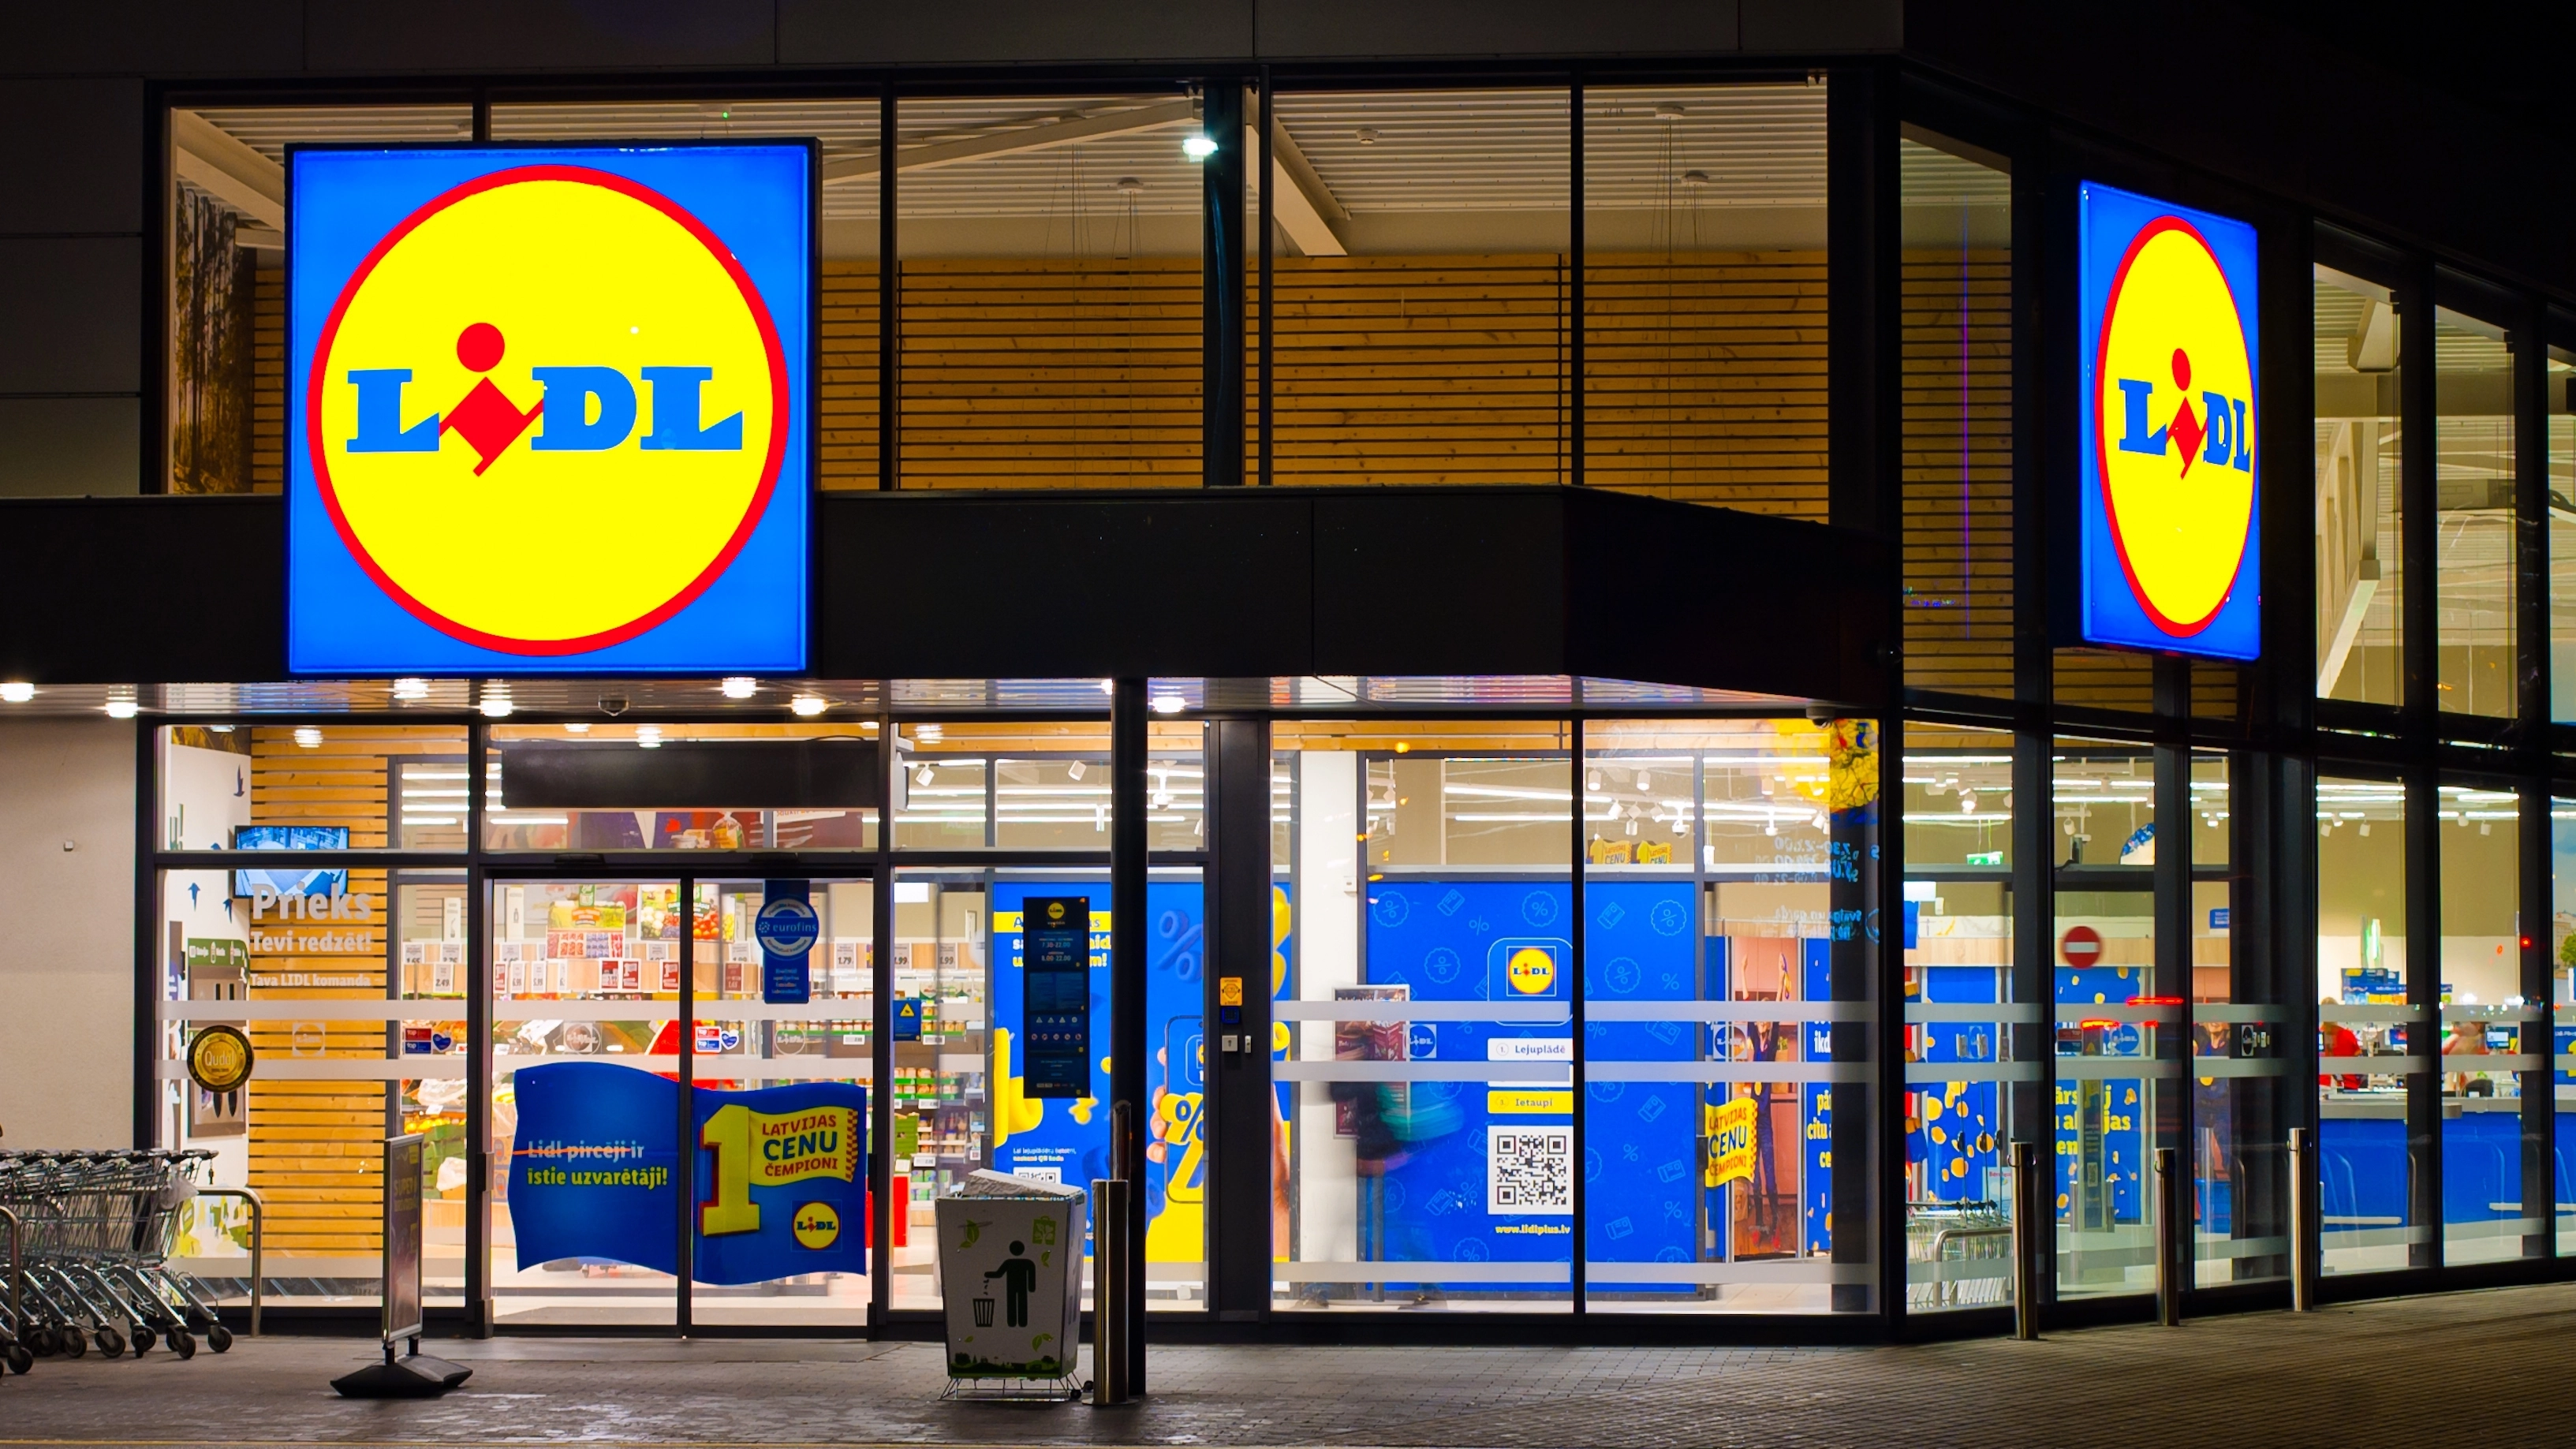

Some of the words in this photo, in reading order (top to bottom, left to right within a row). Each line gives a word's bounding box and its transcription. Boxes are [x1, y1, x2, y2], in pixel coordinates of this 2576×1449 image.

[346, 322, 744, 476] LIDL
[2118, 348, 2251, 480] LIDL
[252, 881, 371, 920] Prieks
[773, 921, 817, 932] eurofins
[251, 930, 293, 952] Tevi
[298, 931, 372, 952] redzēt!
[250, 973, 279, 986] Tava
[281, 973, 311, 986] LIDL
[313, 973, 371, 986] komanda
[205, 1049, 236, 1066] Qudal
[1515, 1044, 1566, 1058] Lejuplādē
[1515, 1098, 1553, 1108] Ietaupi
[762, 1115, 837, 1136] LATVIJAS
[1708, 1107, 1747, 1130] LATVIJAS
[528, 1140, 562, 1159] Lidl
[567, 1140, 626, 1163] pircēji
[631, 1140, 644, 1159] ir
[763, 1131, 838, 1161] CENU
[1709, 1126, 1747, 1160] CENU
[699, 1104, 760, 1237] 1
[764, 1157, 838, 1177] ČEMPIONI
[1709, 1155, 1747, 1177] ČEMPIONI
[528, 1166, 566, 1185] īstie
[571, 1166, 668, 1190] uzvarētāji!
[797, 1216, 836, 1233] LIDL
[1495, 1223, 1571, 1237] www.lidlplus.lv
